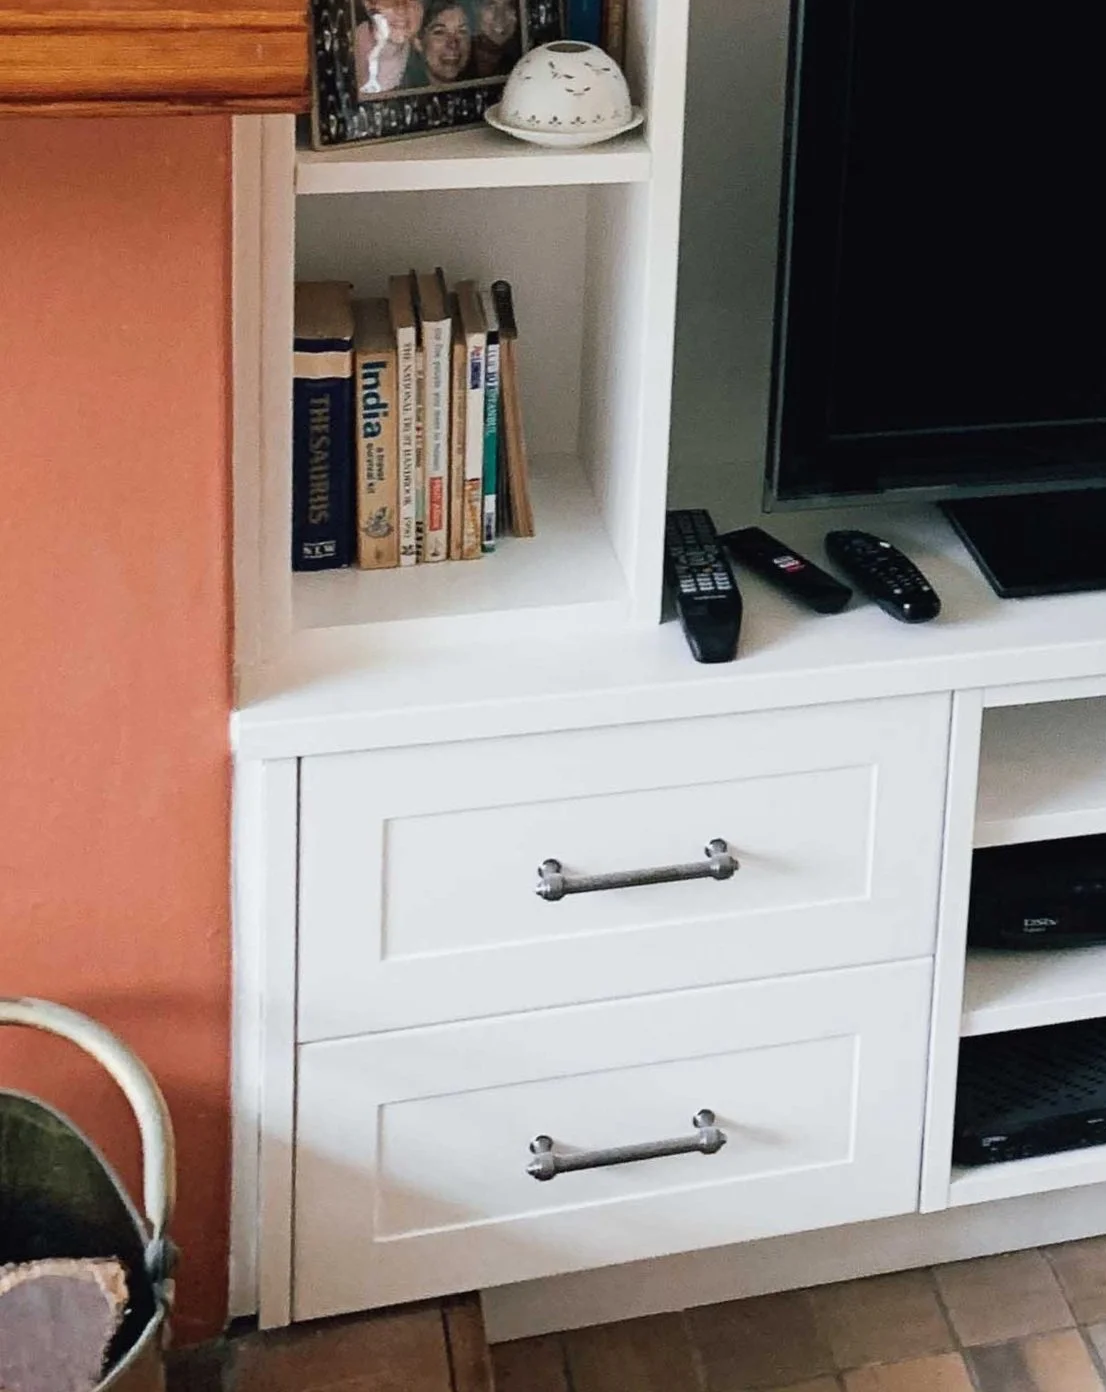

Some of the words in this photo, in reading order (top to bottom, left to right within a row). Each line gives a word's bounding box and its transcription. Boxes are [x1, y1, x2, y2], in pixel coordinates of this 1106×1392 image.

[403, 342, 414, 361] THE
[360, 360, 389, 439] India
[402, 364, 413, 413] NATIONAL
[307, 393, 332, 526] THESAURUS
[365, 442, 376, 481] survival
[376, 454, 386, 482] travel
[402, 448, 413, 506] HANDBOOK
[366, 481, 376, 494] kit
